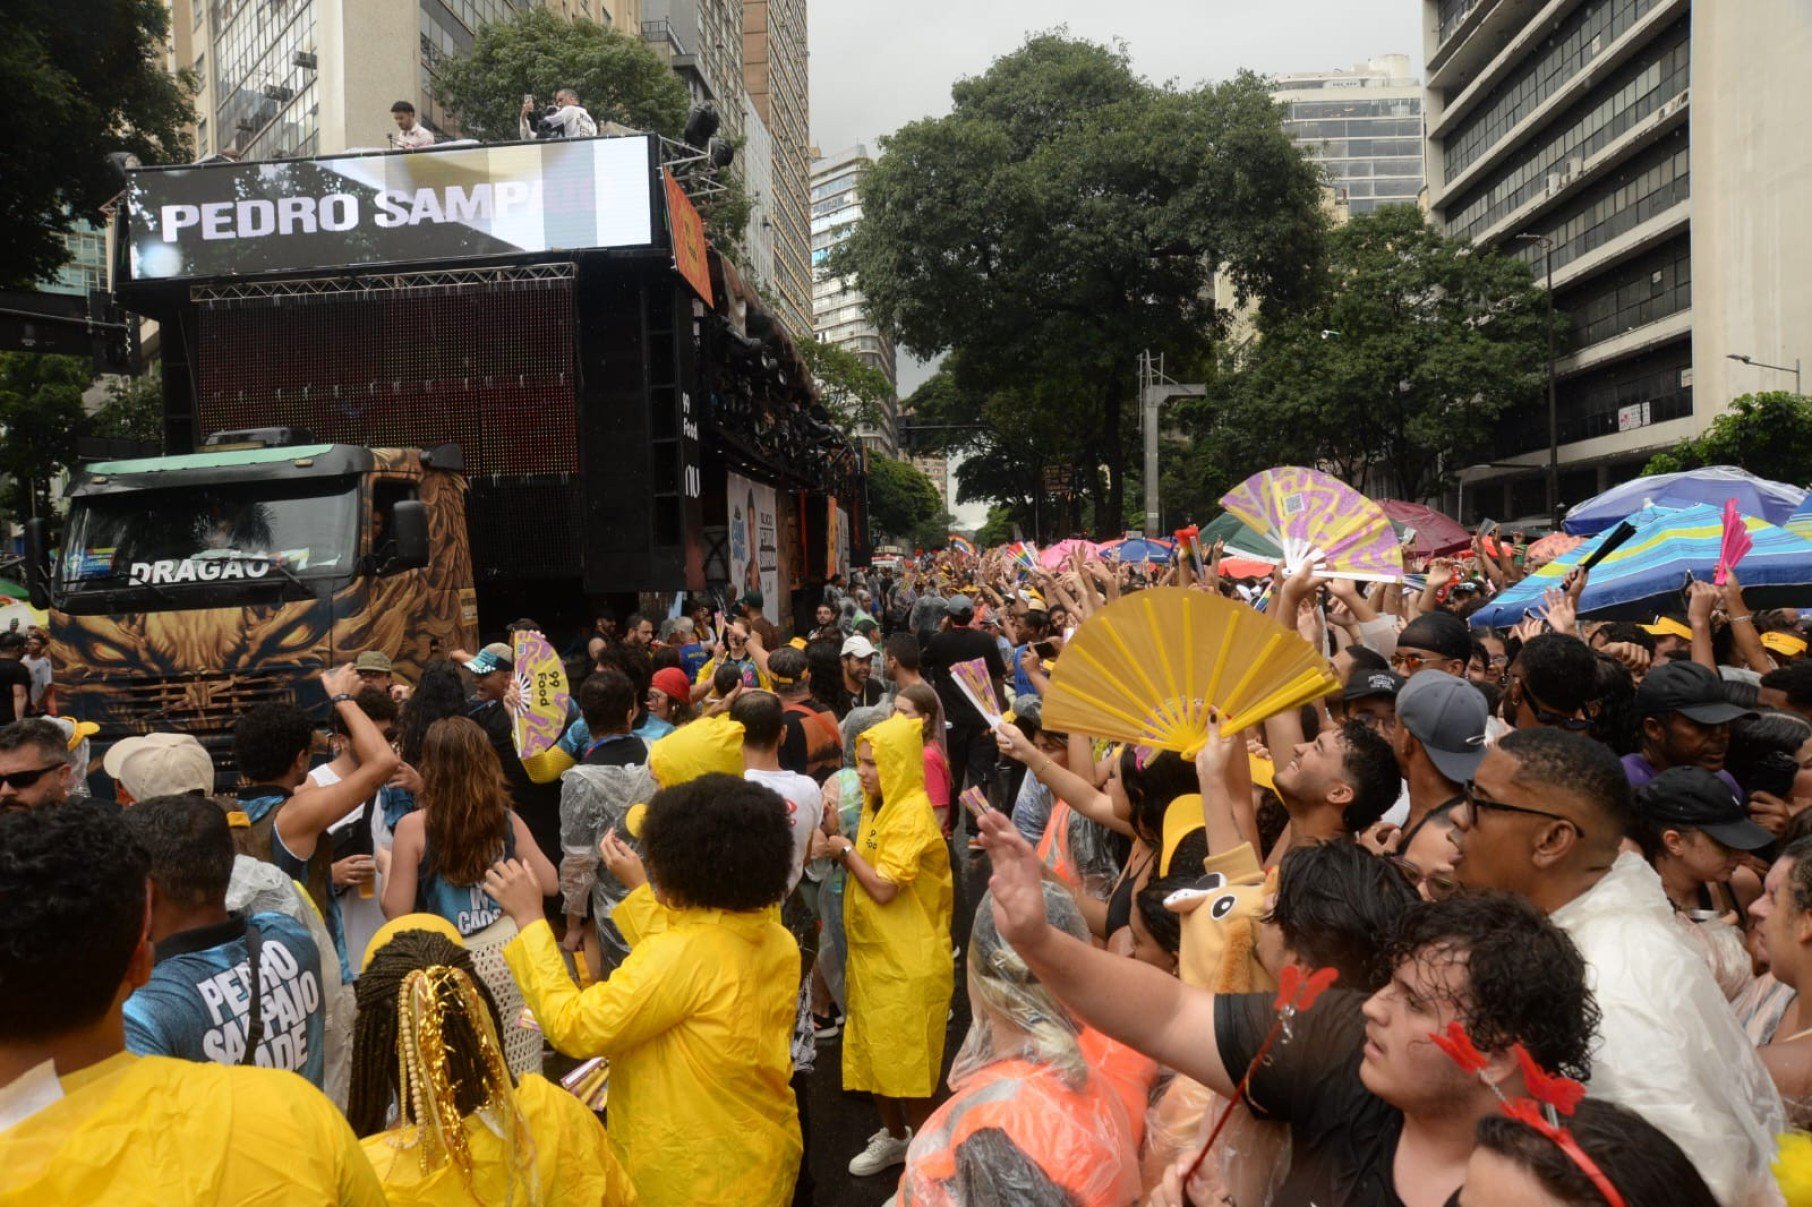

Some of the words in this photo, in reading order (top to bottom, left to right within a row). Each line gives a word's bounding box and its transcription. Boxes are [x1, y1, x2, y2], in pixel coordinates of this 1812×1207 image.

[161, 192, 359, 242] PEDRO
[128, 551, 270, 586] DRAGÃO
[537, 672, 550, 707] Food
[548, 670, 560, 687] 99
[203, 970, 319, 1066] SAPAIO
